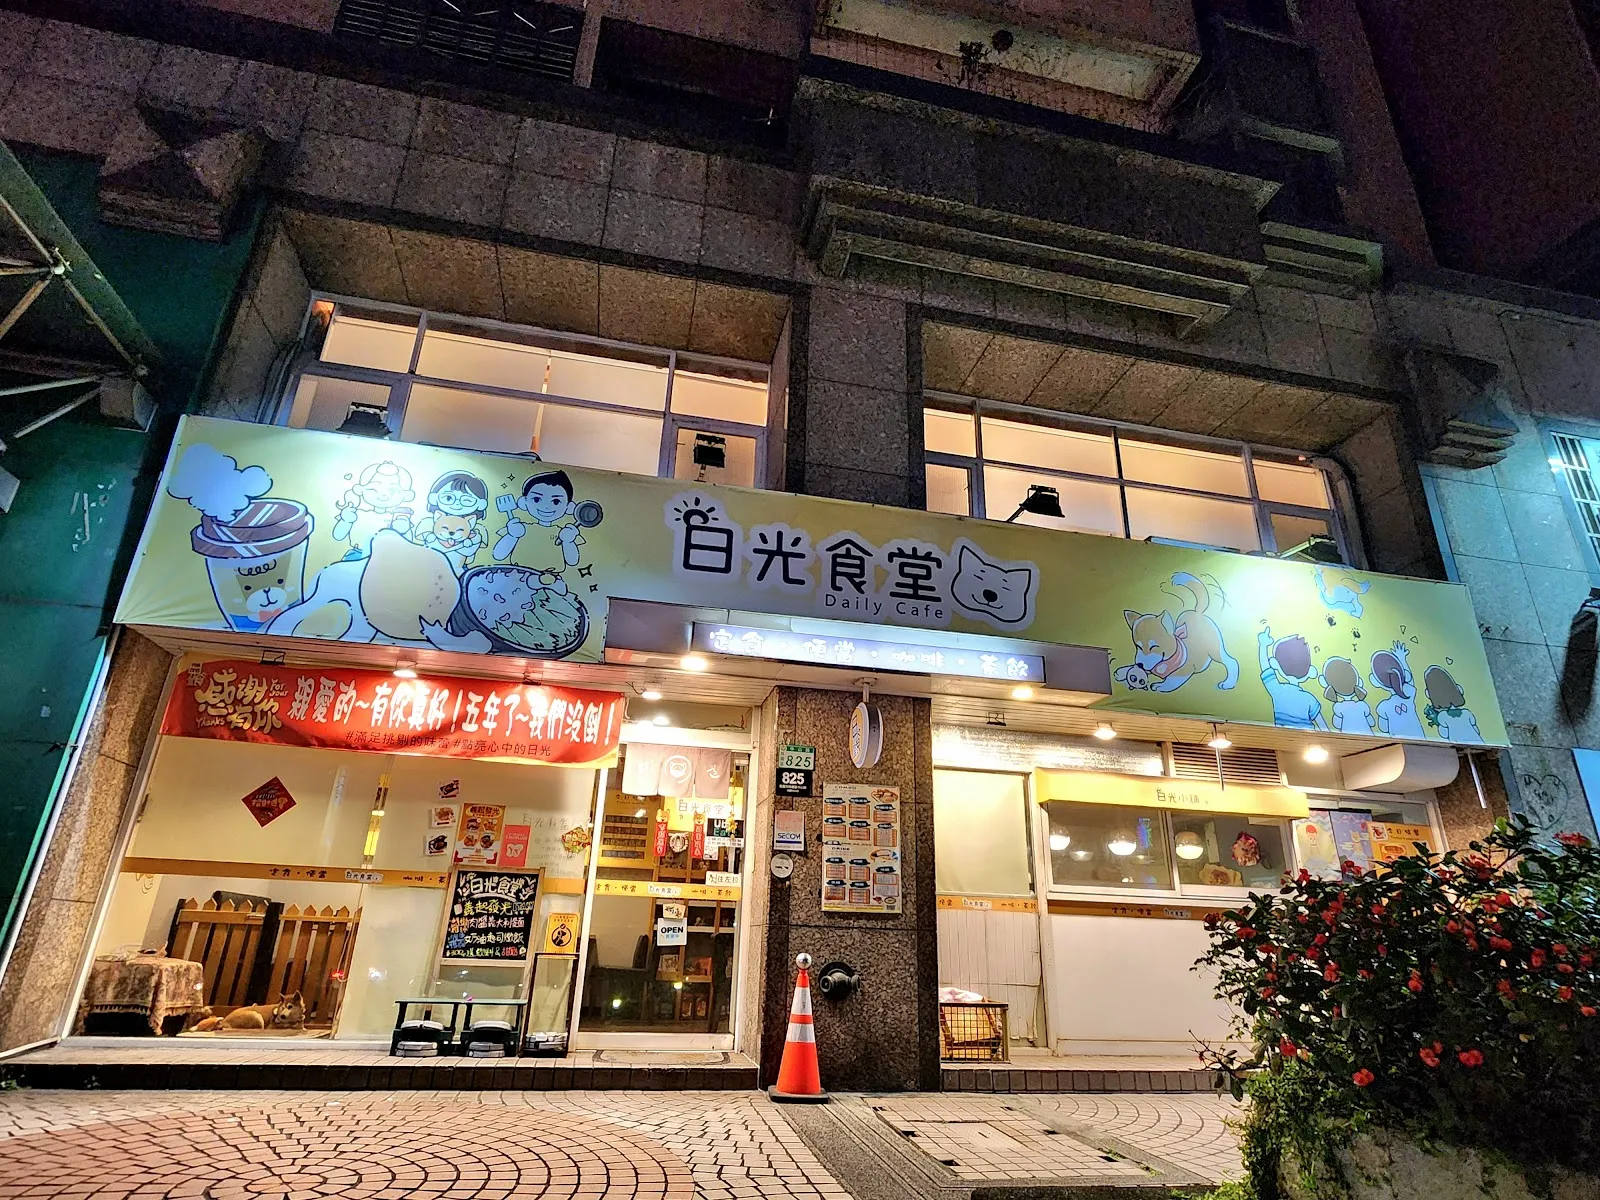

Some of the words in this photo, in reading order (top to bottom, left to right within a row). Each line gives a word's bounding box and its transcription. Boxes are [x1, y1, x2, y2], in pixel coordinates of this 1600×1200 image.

[683, 508, 942, 603] 日光食堂
[825, 593, 882, 615] Daily
[896, 601, 944, 619] Cafe
[195, 716, 226, 729] Thanks
[453, 738, 551, 757] #點亮心中的日光
[786, 755, 812, 768] 825
[782, 771, 805, 785] 825
[714, 818, 738, 828] Ub
[777, 832, 801, 840] SECOM
[660, 926, 684, 934] OPEN
